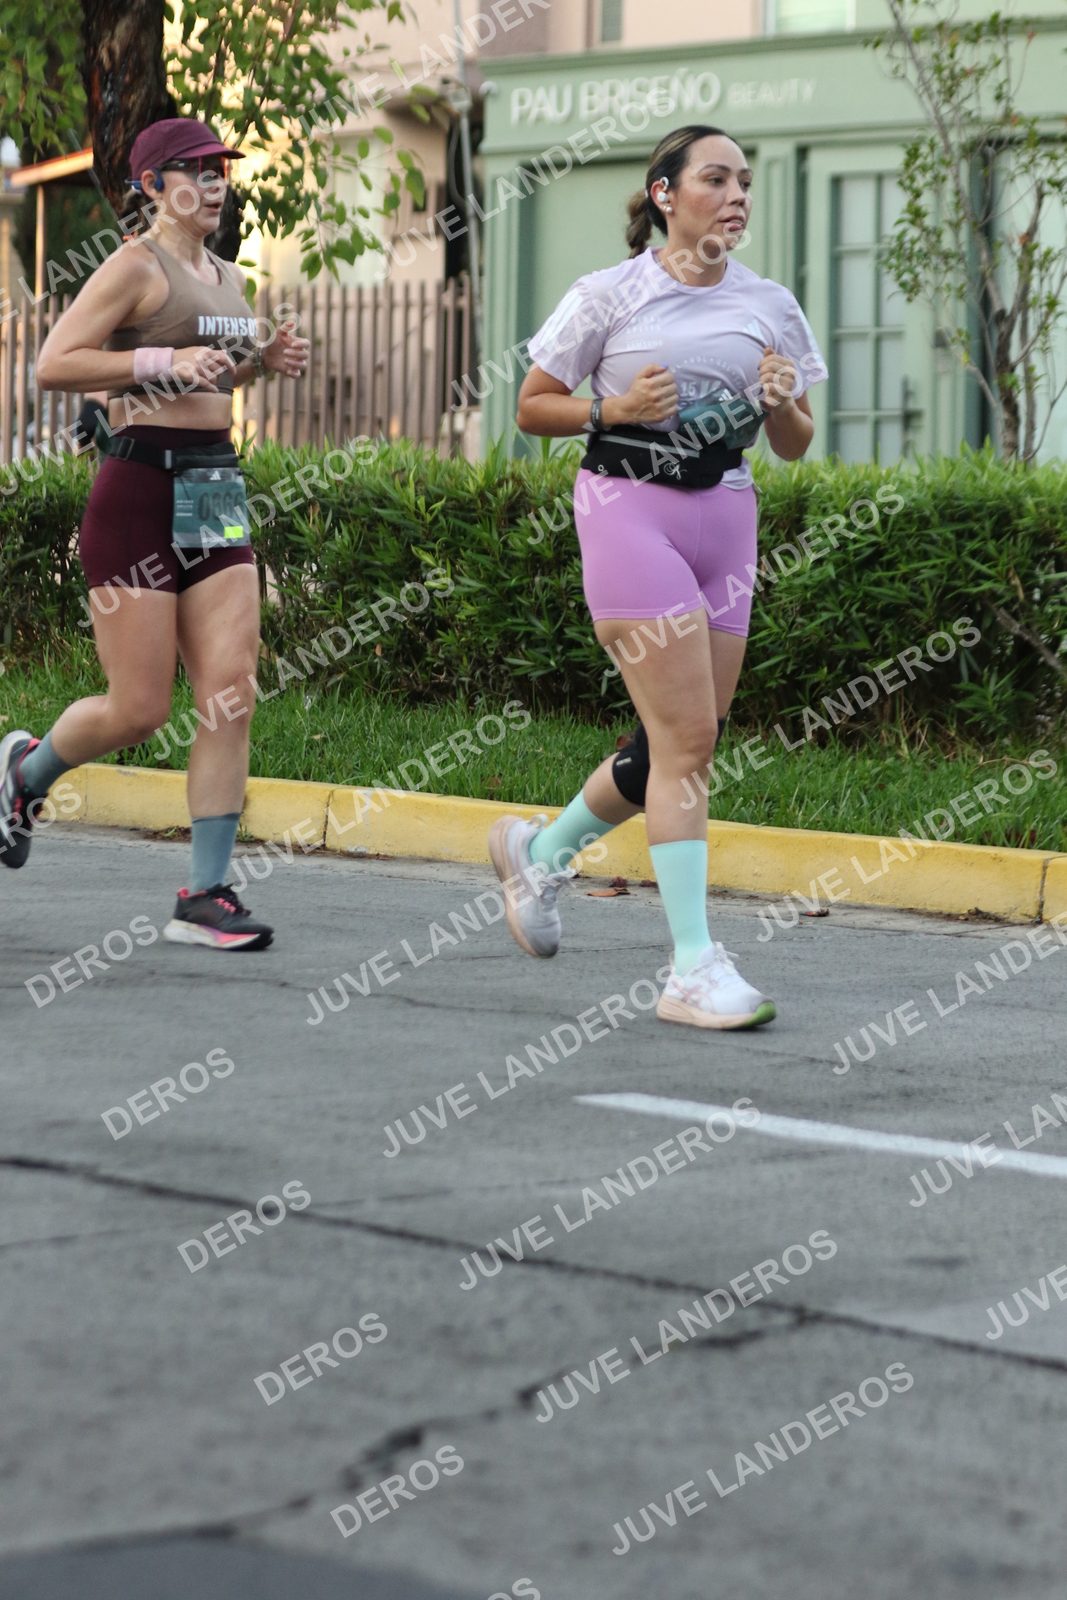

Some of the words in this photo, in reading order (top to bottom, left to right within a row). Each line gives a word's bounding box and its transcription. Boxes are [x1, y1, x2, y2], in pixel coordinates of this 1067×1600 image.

[511, 84, 571, 124] PAU
[579, 69, 720, 119] BRISEÑO
[727, 79, 816, 107] BEAUTY
